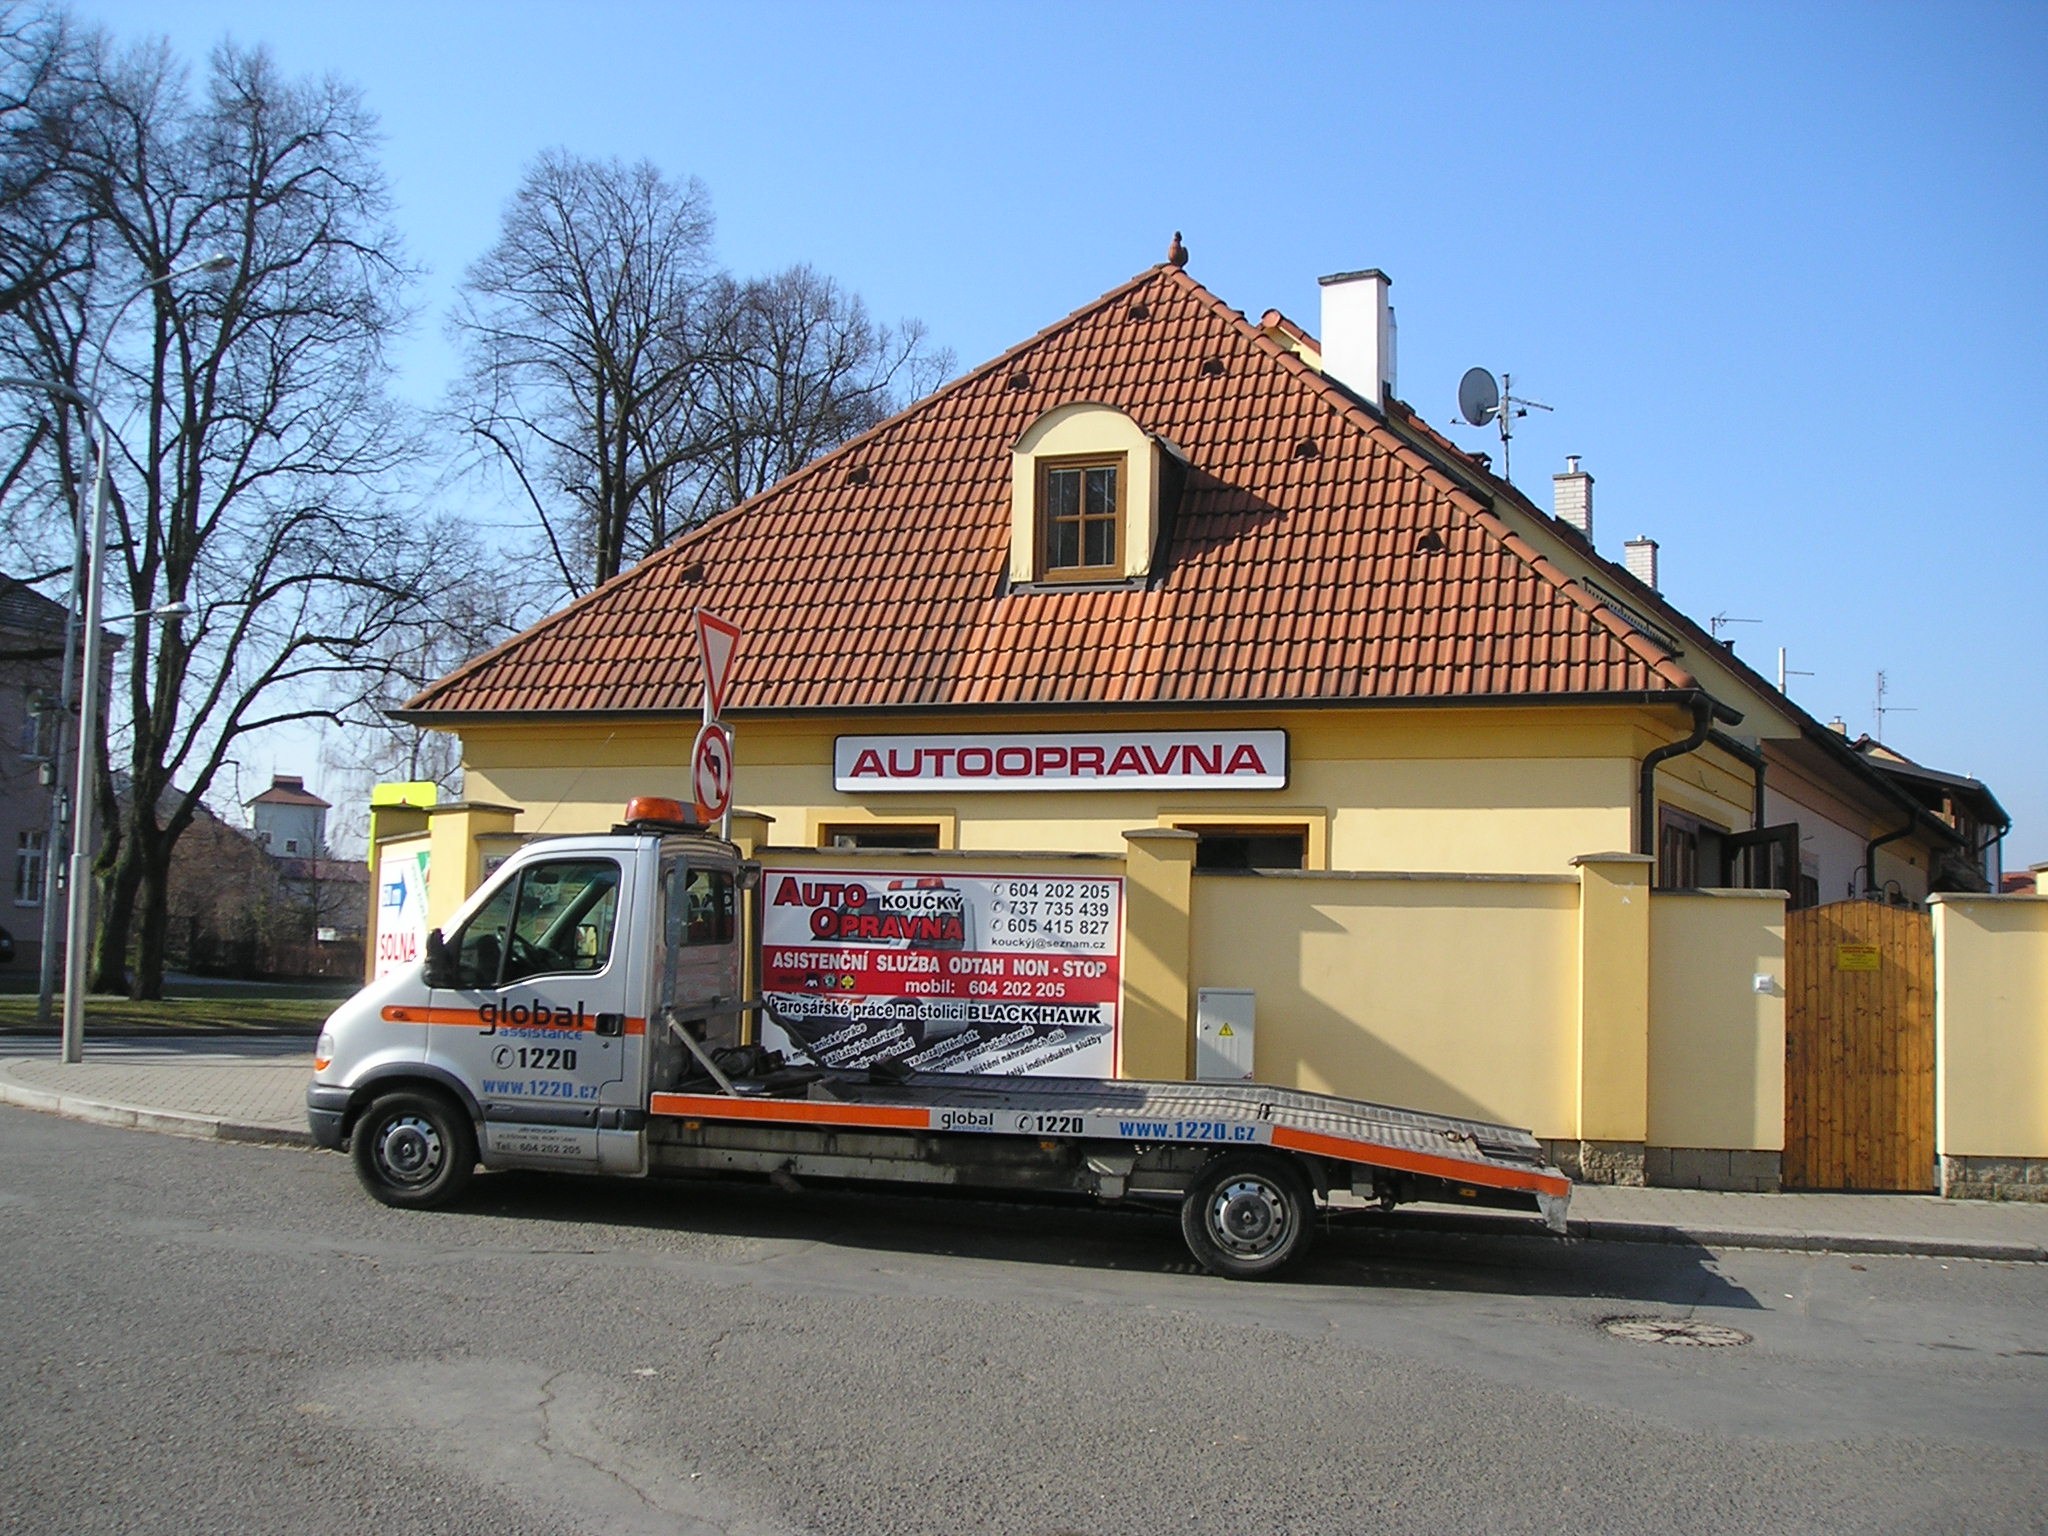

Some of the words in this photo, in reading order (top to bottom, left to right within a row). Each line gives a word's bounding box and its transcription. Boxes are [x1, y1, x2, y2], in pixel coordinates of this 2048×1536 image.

[850, 744, 1267, 778] AUTOOPRAVNA
[773, 877, 868, 908] AUTO
[881, 892, 963, 910] KOUCKÝ
[1009, 883, 1038, 897] 604
[1045, 883, 1074, 898] 202
[1080, 885, 1110, 899] 205
[1009, 901, 1038, 915] 737
[1045, 902, 1073, 916] 735
[1079, 902, 1108, 917] 439
[810, 907, 965, 941] OPRAVNA
[1008, 919, 1037, 933] 605
[1043, 919, 1073, 934] 415
[1079, 921, 1109, 935] 827
[381, 926, 417, 961] SOLNÁ
[772, 950, 869, 971] ASISTENČNÍ
[876, 952, 940, 973] SLUŽBA
[949, 957, 1004, 975] ODTAH
[905, 979, 955, 994] mobil:
[969, 980, 997, 995] 604
[1003, 981, 1031, 996] 202
[1035, 982, 1065, 997] 205
[479, 997, 584, 1035] global
[771, 998, 849, 1016] karosářské
[853, 1001, 893, 1019] práce
[898, 1007, 914, 1018] na
[920, 1004, 963, 1020] stolici
[968, 1006, 1038, 1022] BLACK
[1042, 1008, 1101, 1024] HAWK
[499, 1027, 583, 1041] assistance
[518, 1048, 577, 1070] 1220
[483, 1080, 598, 1099] www.1220.cz
[941, 1111, 993, 1129] global
[1036, 1115, 1083, 1134] 1220
[1119, 1120, 1256, 1142] www.1220.cz
